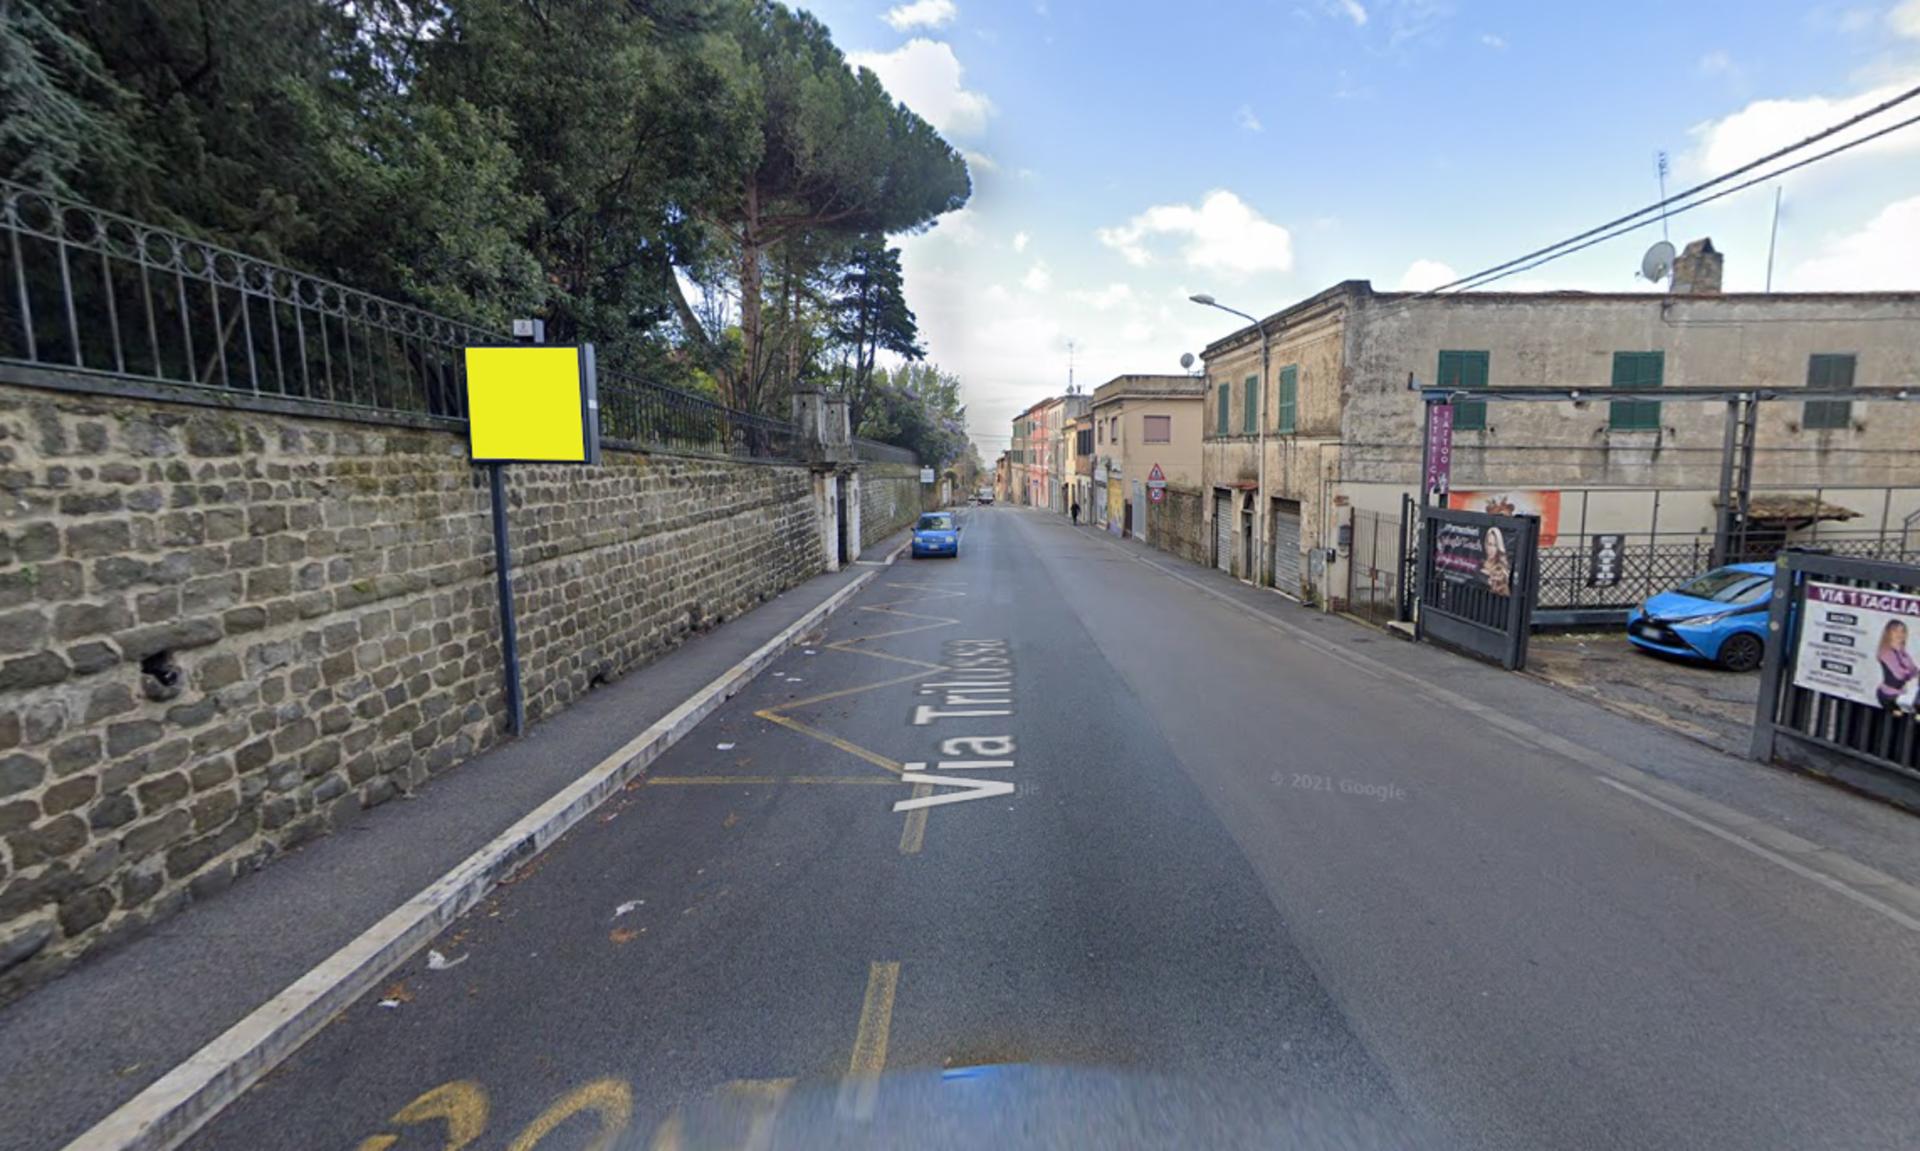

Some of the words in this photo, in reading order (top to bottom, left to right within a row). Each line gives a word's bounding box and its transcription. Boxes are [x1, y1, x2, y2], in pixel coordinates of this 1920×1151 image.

[1429, 405, 1439, 484] ESTETICA
[1440, 411, 1449, 465] TATTOO
[1819, 588, 1844, 604] VIA
